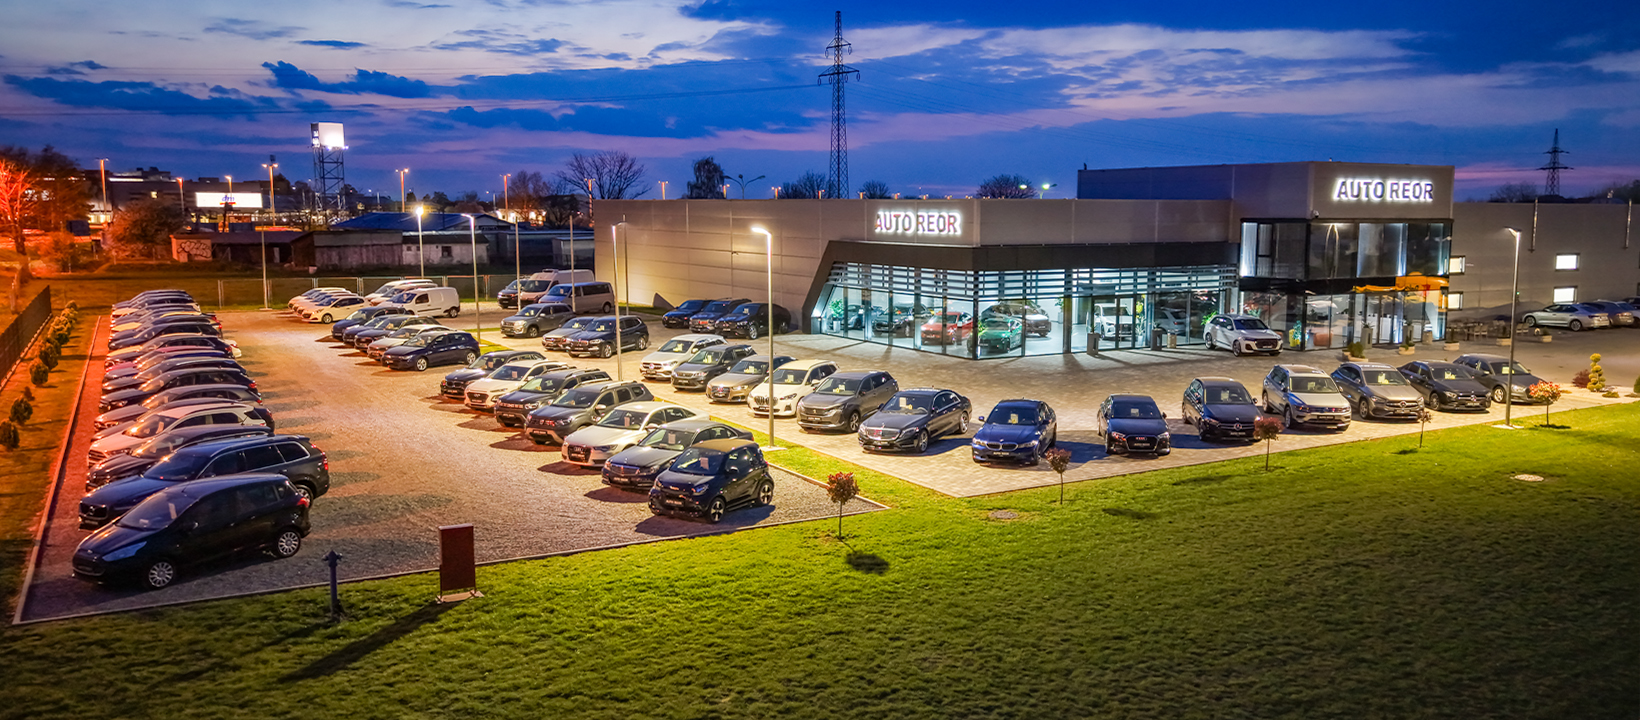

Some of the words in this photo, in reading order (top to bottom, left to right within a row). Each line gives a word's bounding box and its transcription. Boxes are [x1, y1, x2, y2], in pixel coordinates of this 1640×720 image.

[1335, 180, 1386, 200] AUTO
[1388, 181, 1434, 201] REOR
[874, 212, 914, 233] AUTO
[916, 213, 960, 235] REOR
